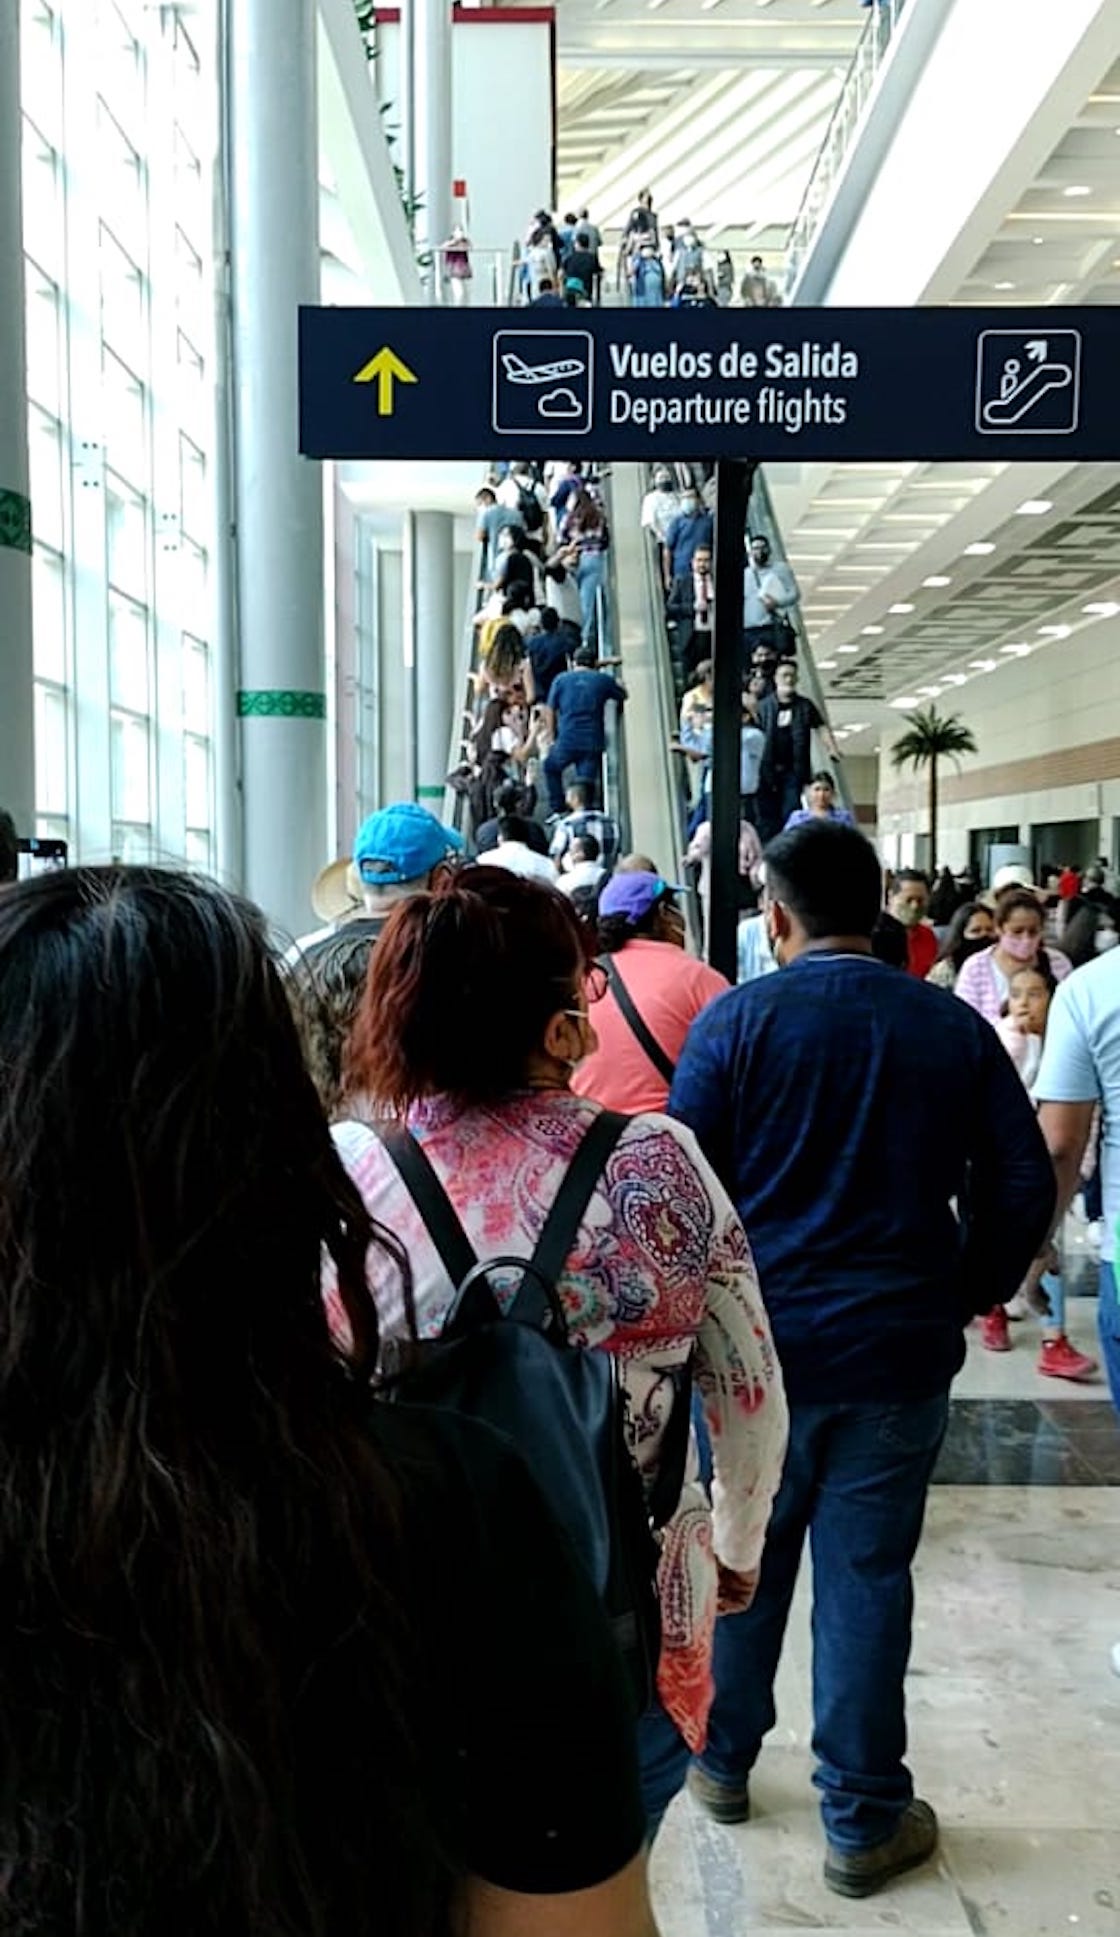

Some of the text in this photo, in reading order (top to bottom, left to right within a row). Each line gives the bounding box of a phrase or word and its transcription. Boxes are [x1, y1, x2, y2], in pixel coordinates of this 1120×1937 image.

[609, 342, 857, 378] Vuelos de Salida
[610, 386, 846, 433] Departure flights
